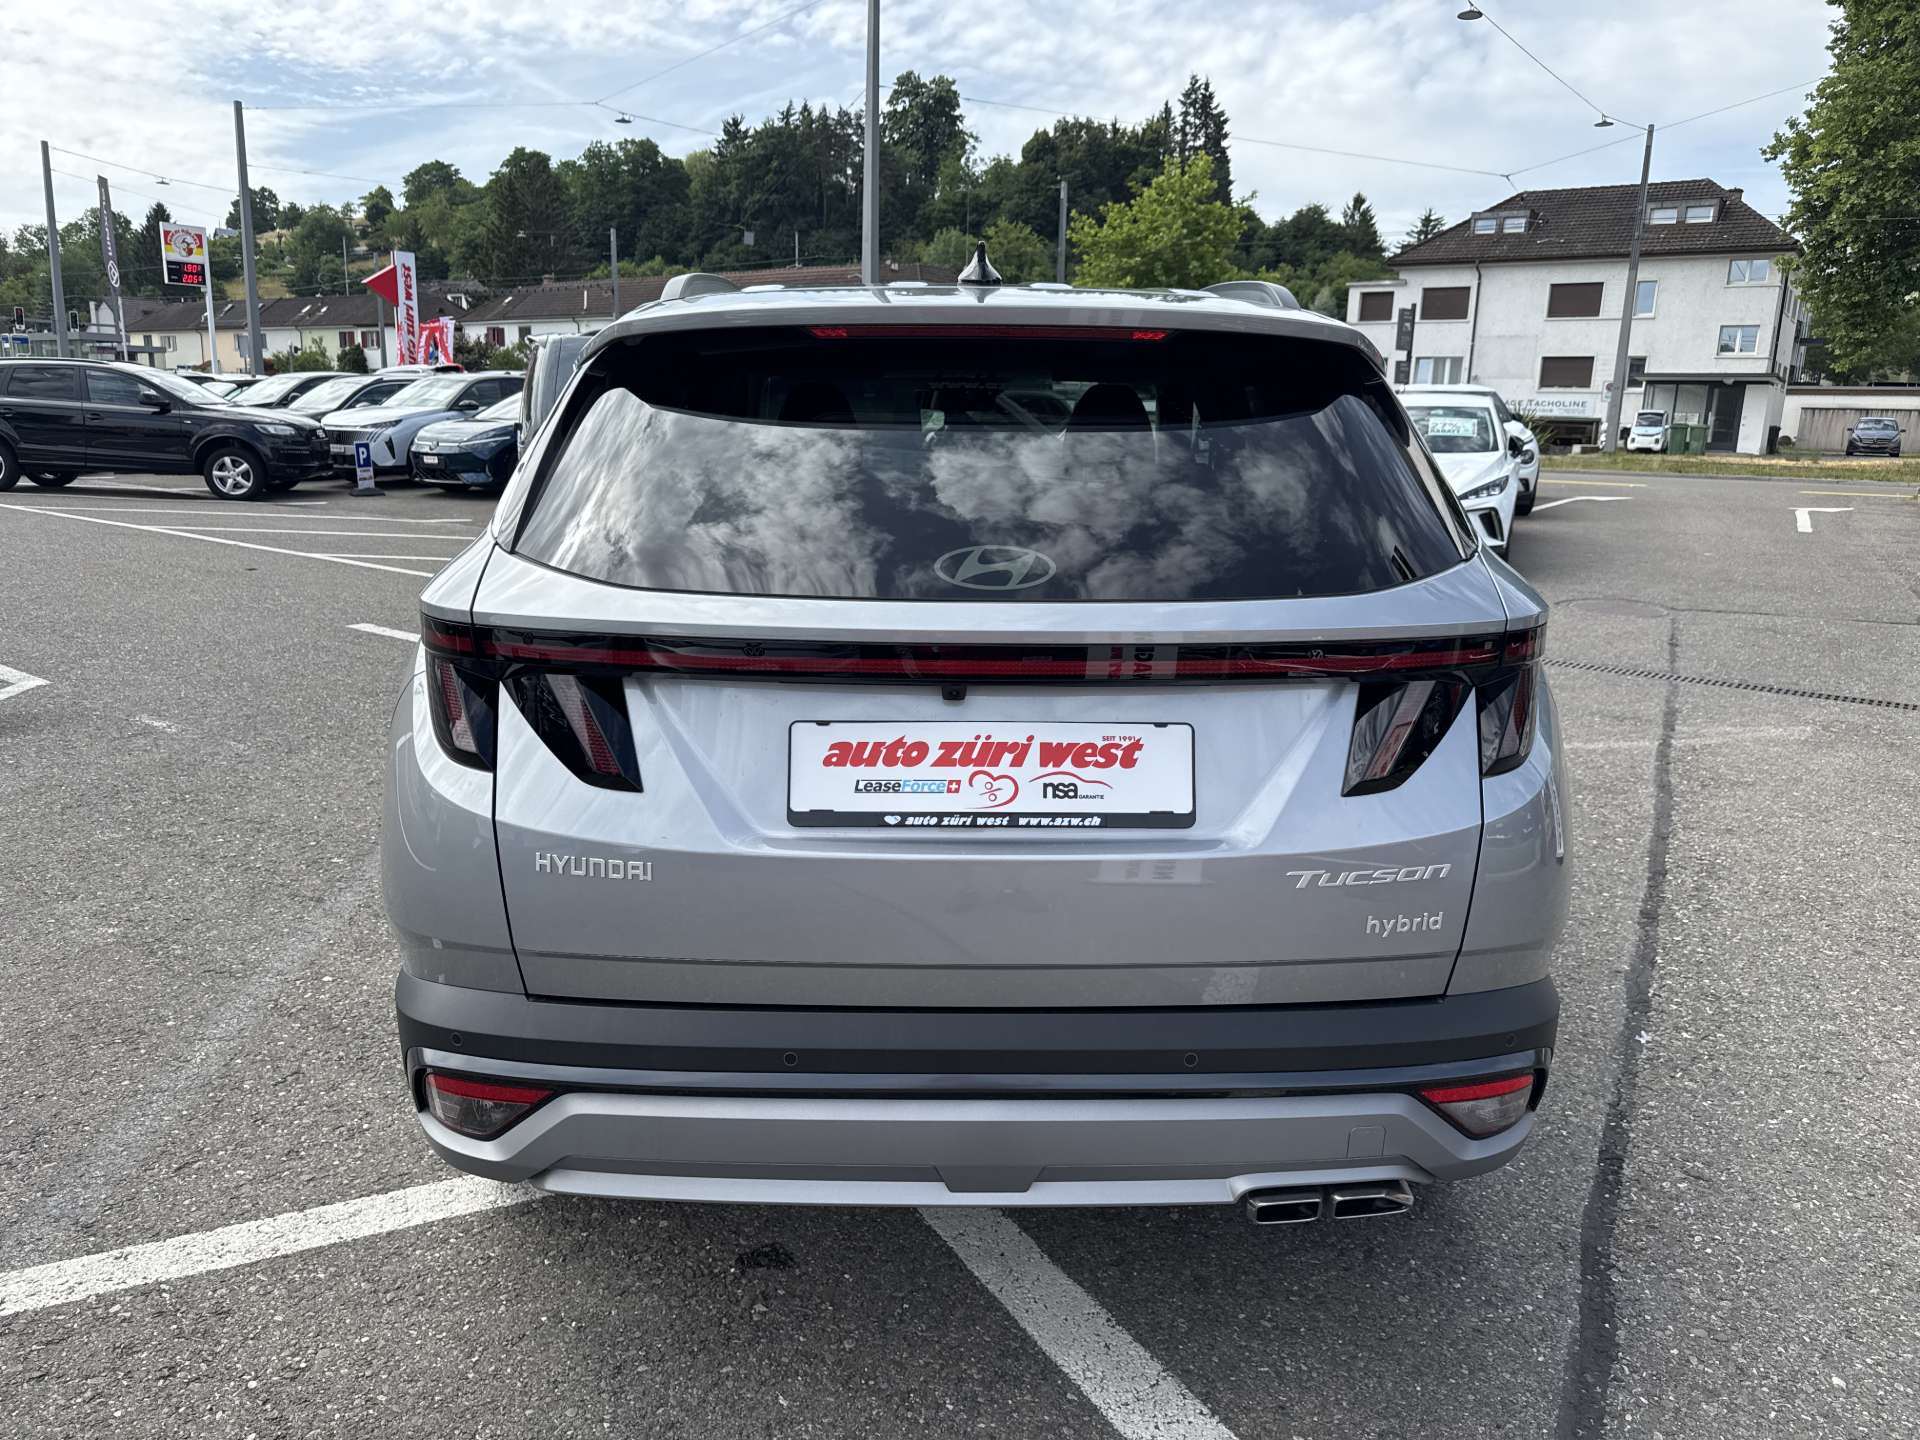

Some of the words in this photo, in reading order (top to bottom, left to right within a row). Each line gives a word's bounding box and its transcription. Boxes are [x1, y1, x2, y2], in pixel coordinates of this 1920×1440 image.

[402, 263, 414, 301] west
[1528, 400, 1588, 409] TACHOLINE
[358, 447, 368, 465] P
[822, 735, 930, 768] auto
[930, 734, 1035, 768] züri
[1039, 736, 1145, 770] west
[854, 779, 947, 793] LeaseForce
[1042, 782, 1079, 800] nsa
[904, 816, 938, 826] auto
[940, 814, 973, 826] züri
[976, 816, 1010, 826] west
[1018, 816, 1102, 826] www.azw.ch
[535, 851, 653, 881] HYUNDAI
[1365, 911, 1444, 938] hybrid
